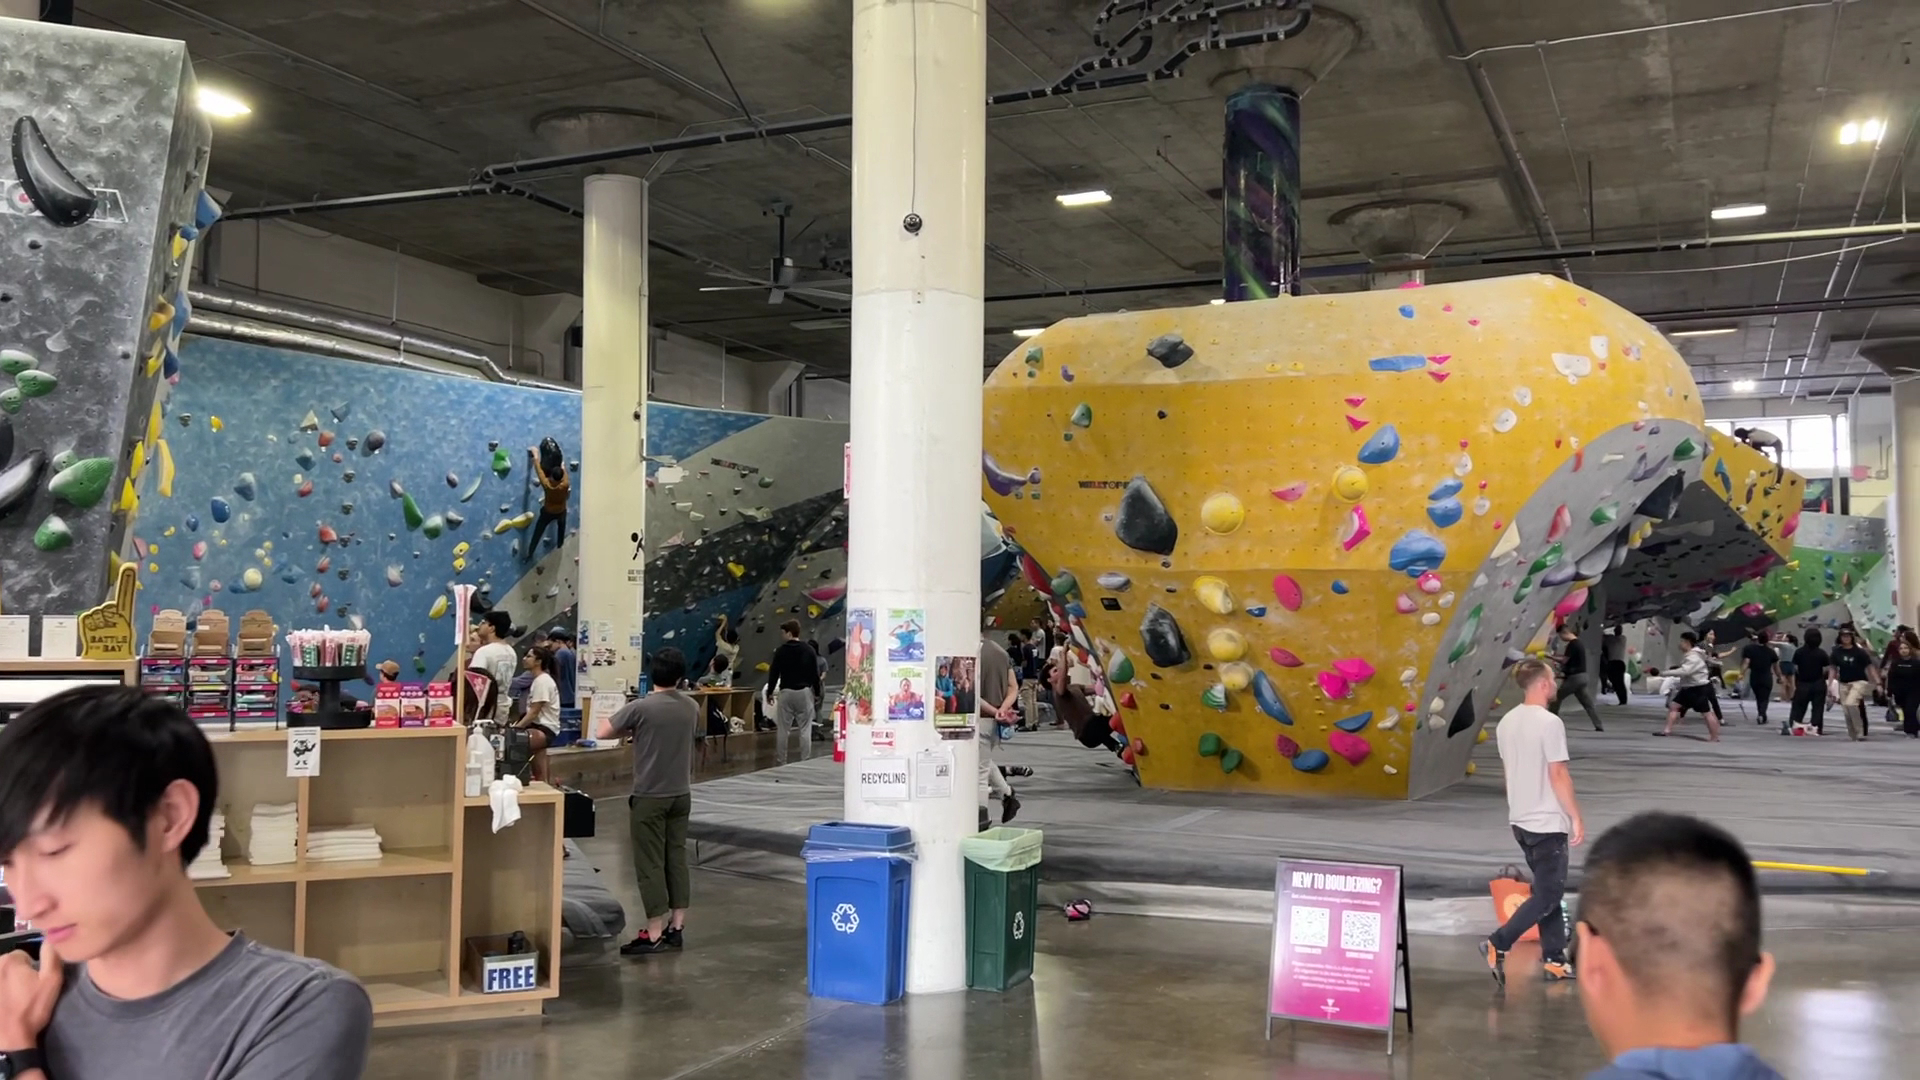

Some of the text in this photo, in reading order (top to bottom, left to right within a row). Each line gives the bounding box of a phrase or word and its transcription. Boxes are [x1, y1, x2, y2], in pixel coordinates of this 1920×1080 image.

[90, 635, 128, 644] BATTLE
[871, 731, 894, 739] FIRST AID
[861, 773, 906, 784] RECYCLING
[1292, 871, 1383, 894] NEW TO BOULDERING?
[487, 965, 535, 991] FREE
